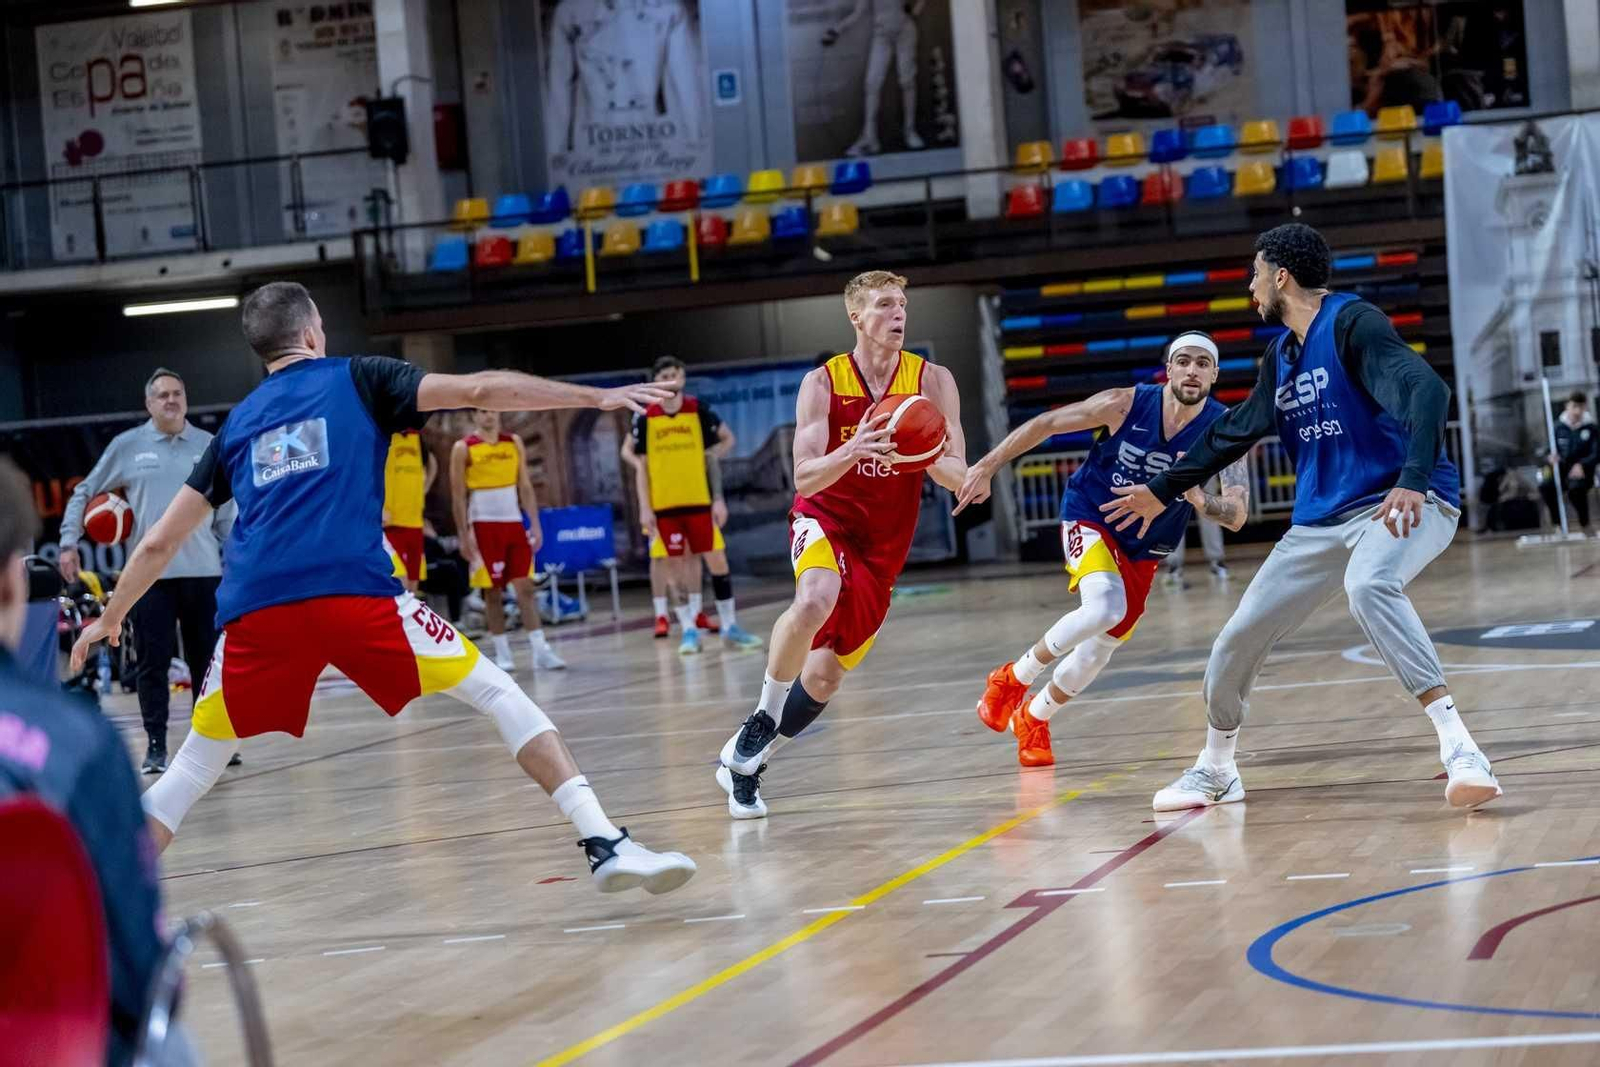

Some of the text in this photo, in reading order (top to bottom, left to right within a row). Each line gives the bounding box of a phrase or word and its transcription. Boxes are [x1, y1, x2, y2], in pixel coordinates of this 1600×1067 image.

[1275, 367, 1329, 411] ESP
[261, 456, 319, 481] CaixaBank
[1118, 440, 1173, 475] ES
[412, 601, 455, 644] ESP
